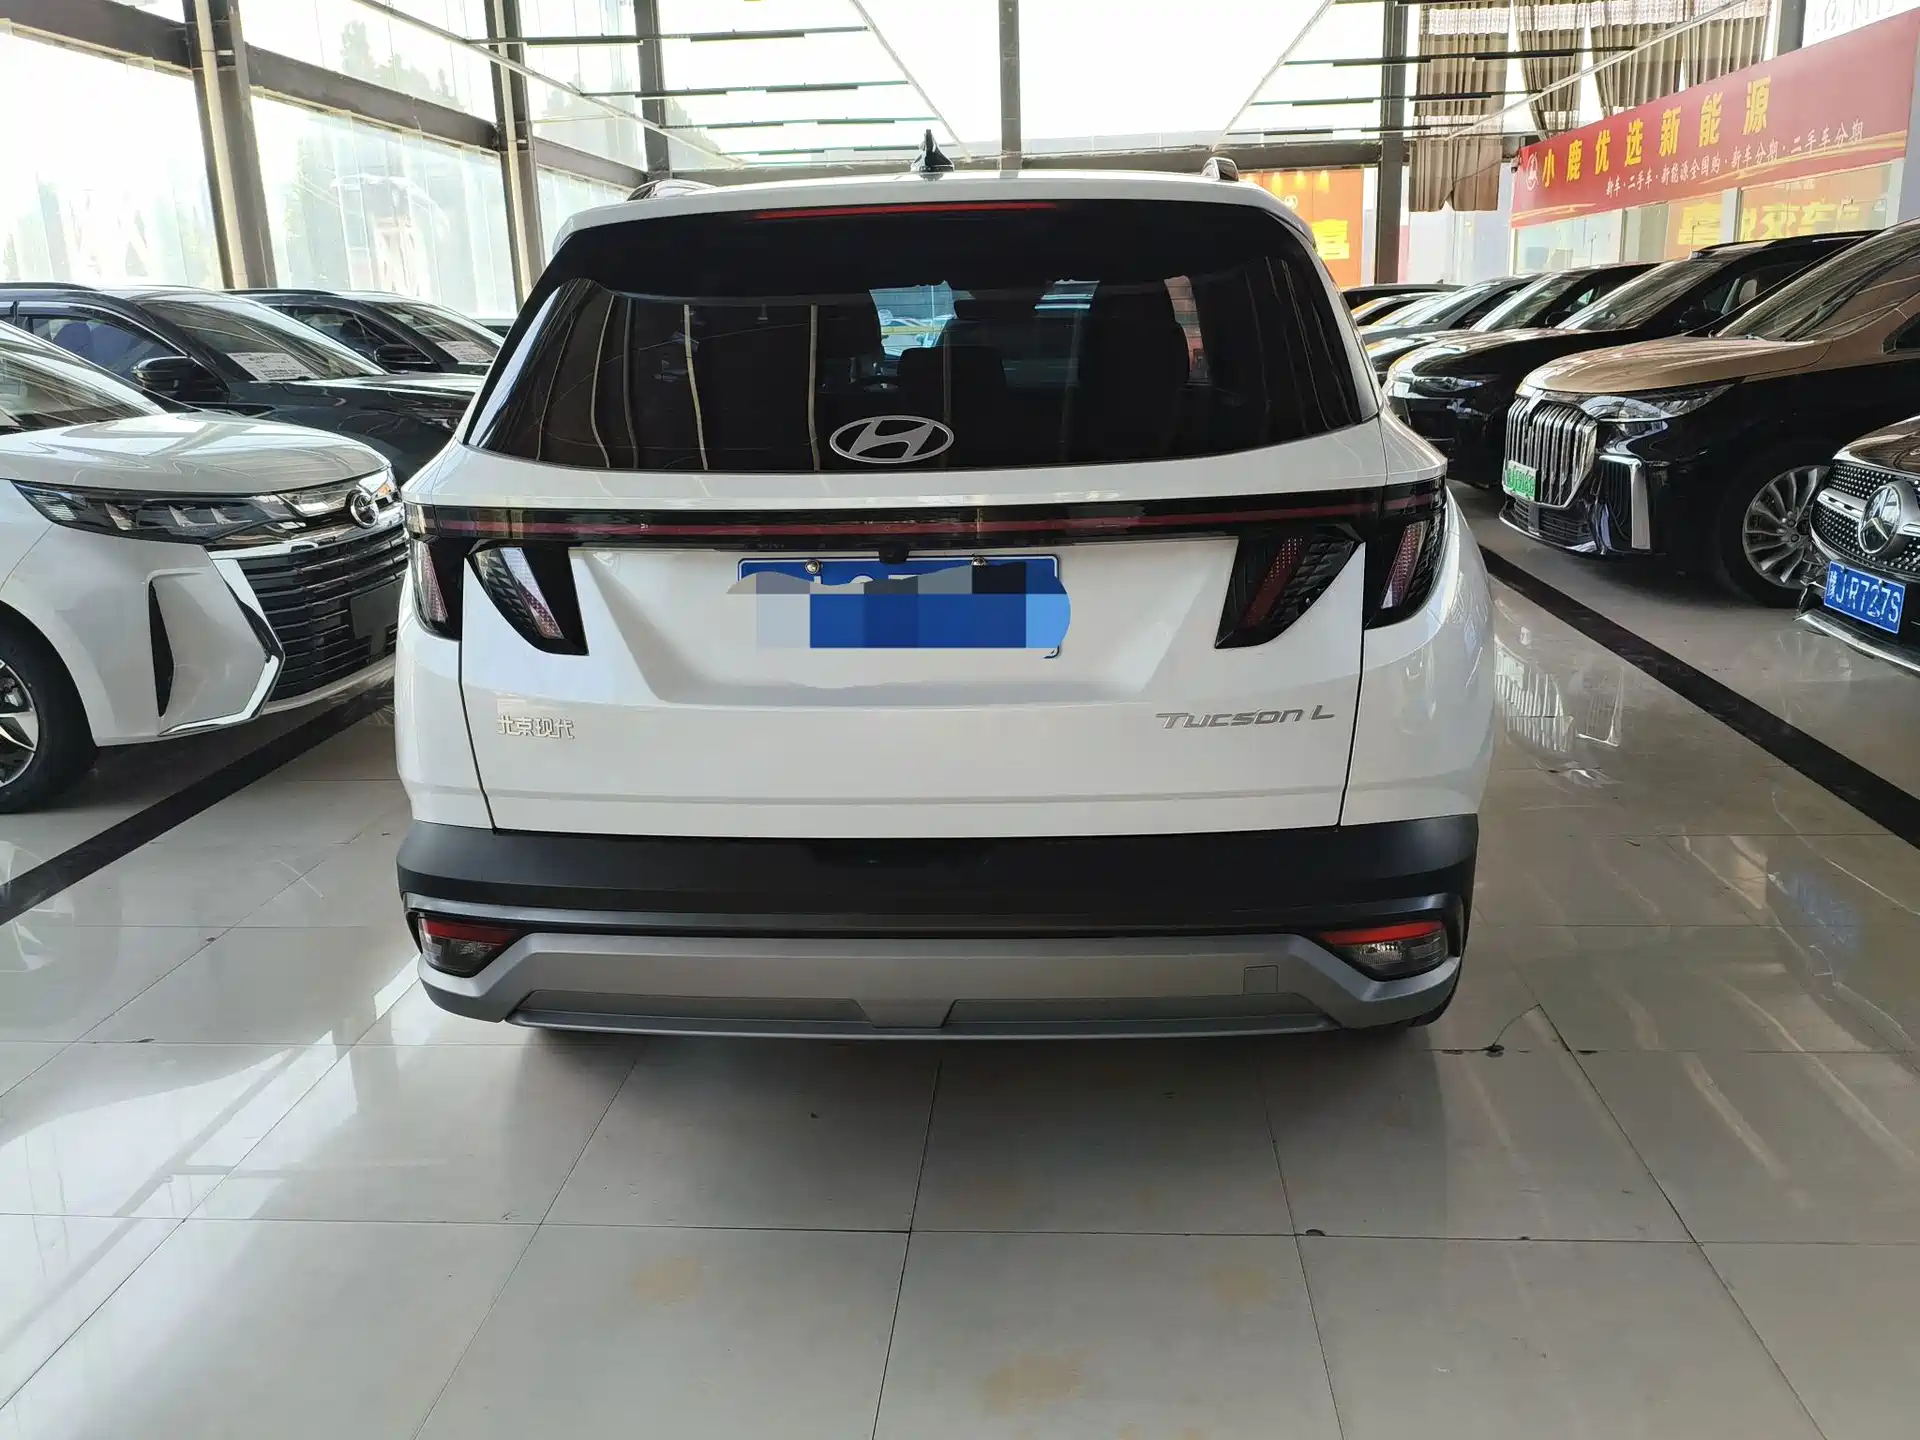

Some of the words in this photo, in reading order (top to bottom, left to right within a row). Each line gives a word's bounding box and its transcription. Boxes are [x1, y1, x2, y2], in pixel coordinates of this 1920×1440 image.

[1542, 76, 1771, 188] 小鹿优选新能源
[1310, 704, 1335, 720] L
[496, 714, 576, 740] 北京现代
